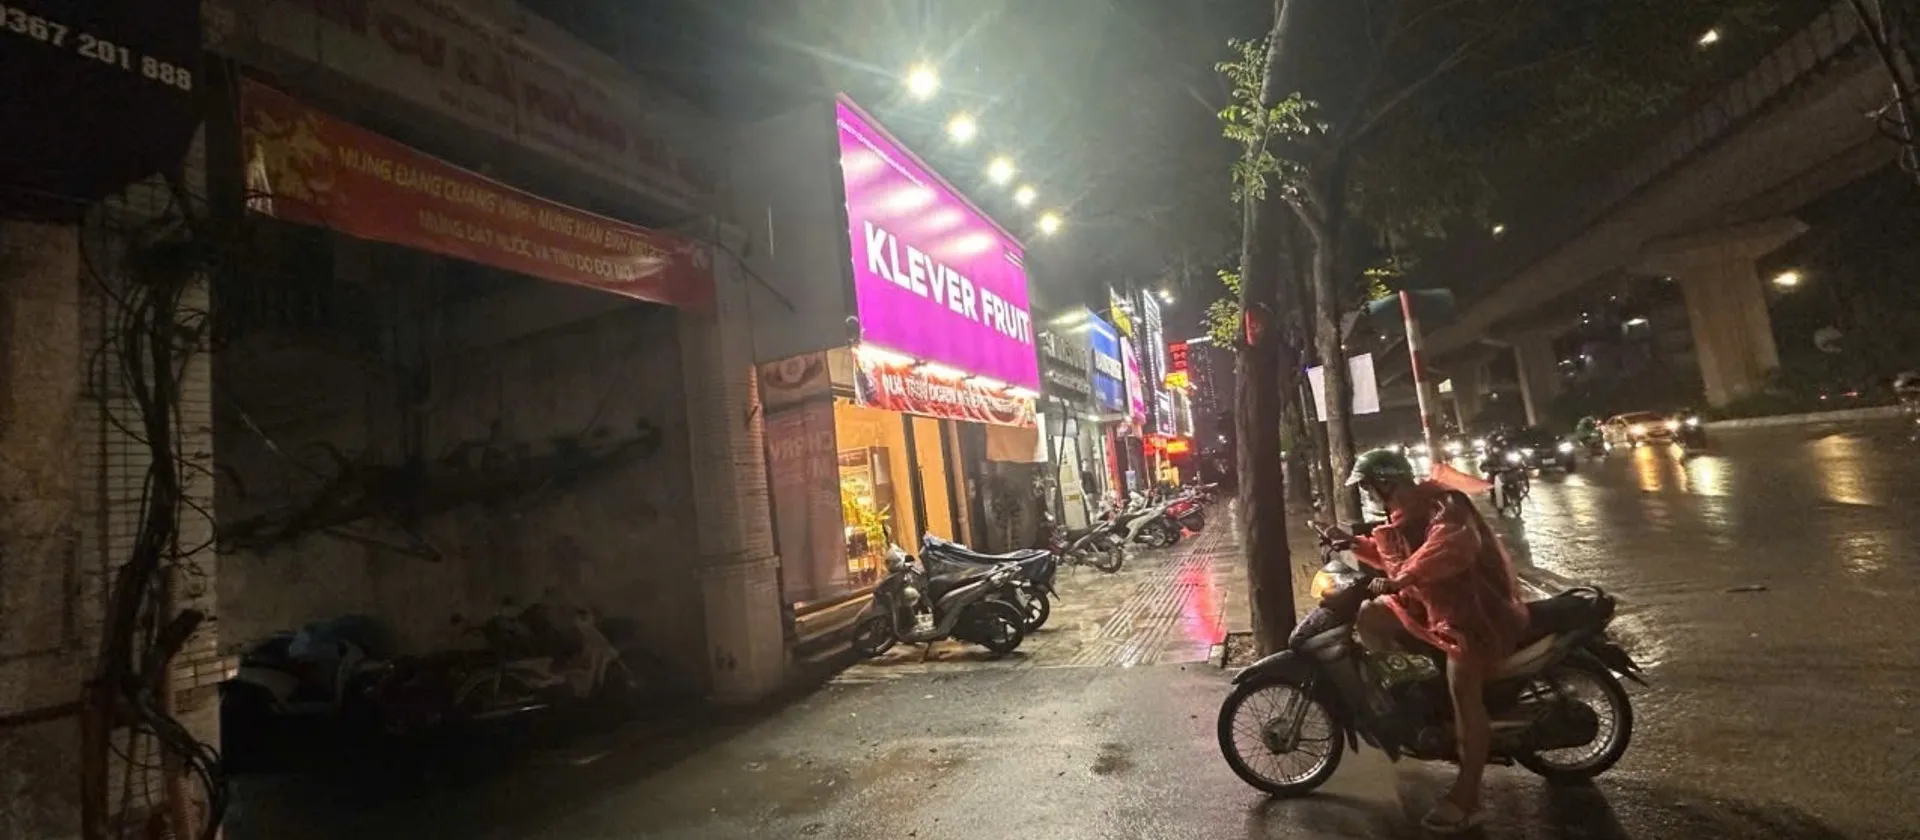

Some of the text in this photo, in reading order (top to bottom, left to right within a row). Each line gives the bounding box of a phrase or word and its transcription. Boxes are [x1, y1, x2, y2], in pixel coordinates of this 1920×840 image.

[77, 33, 132, 71] 201
[142, 55, 192, 92] 888
[863, 219, 1031, 345] KLEVER FRUIT
